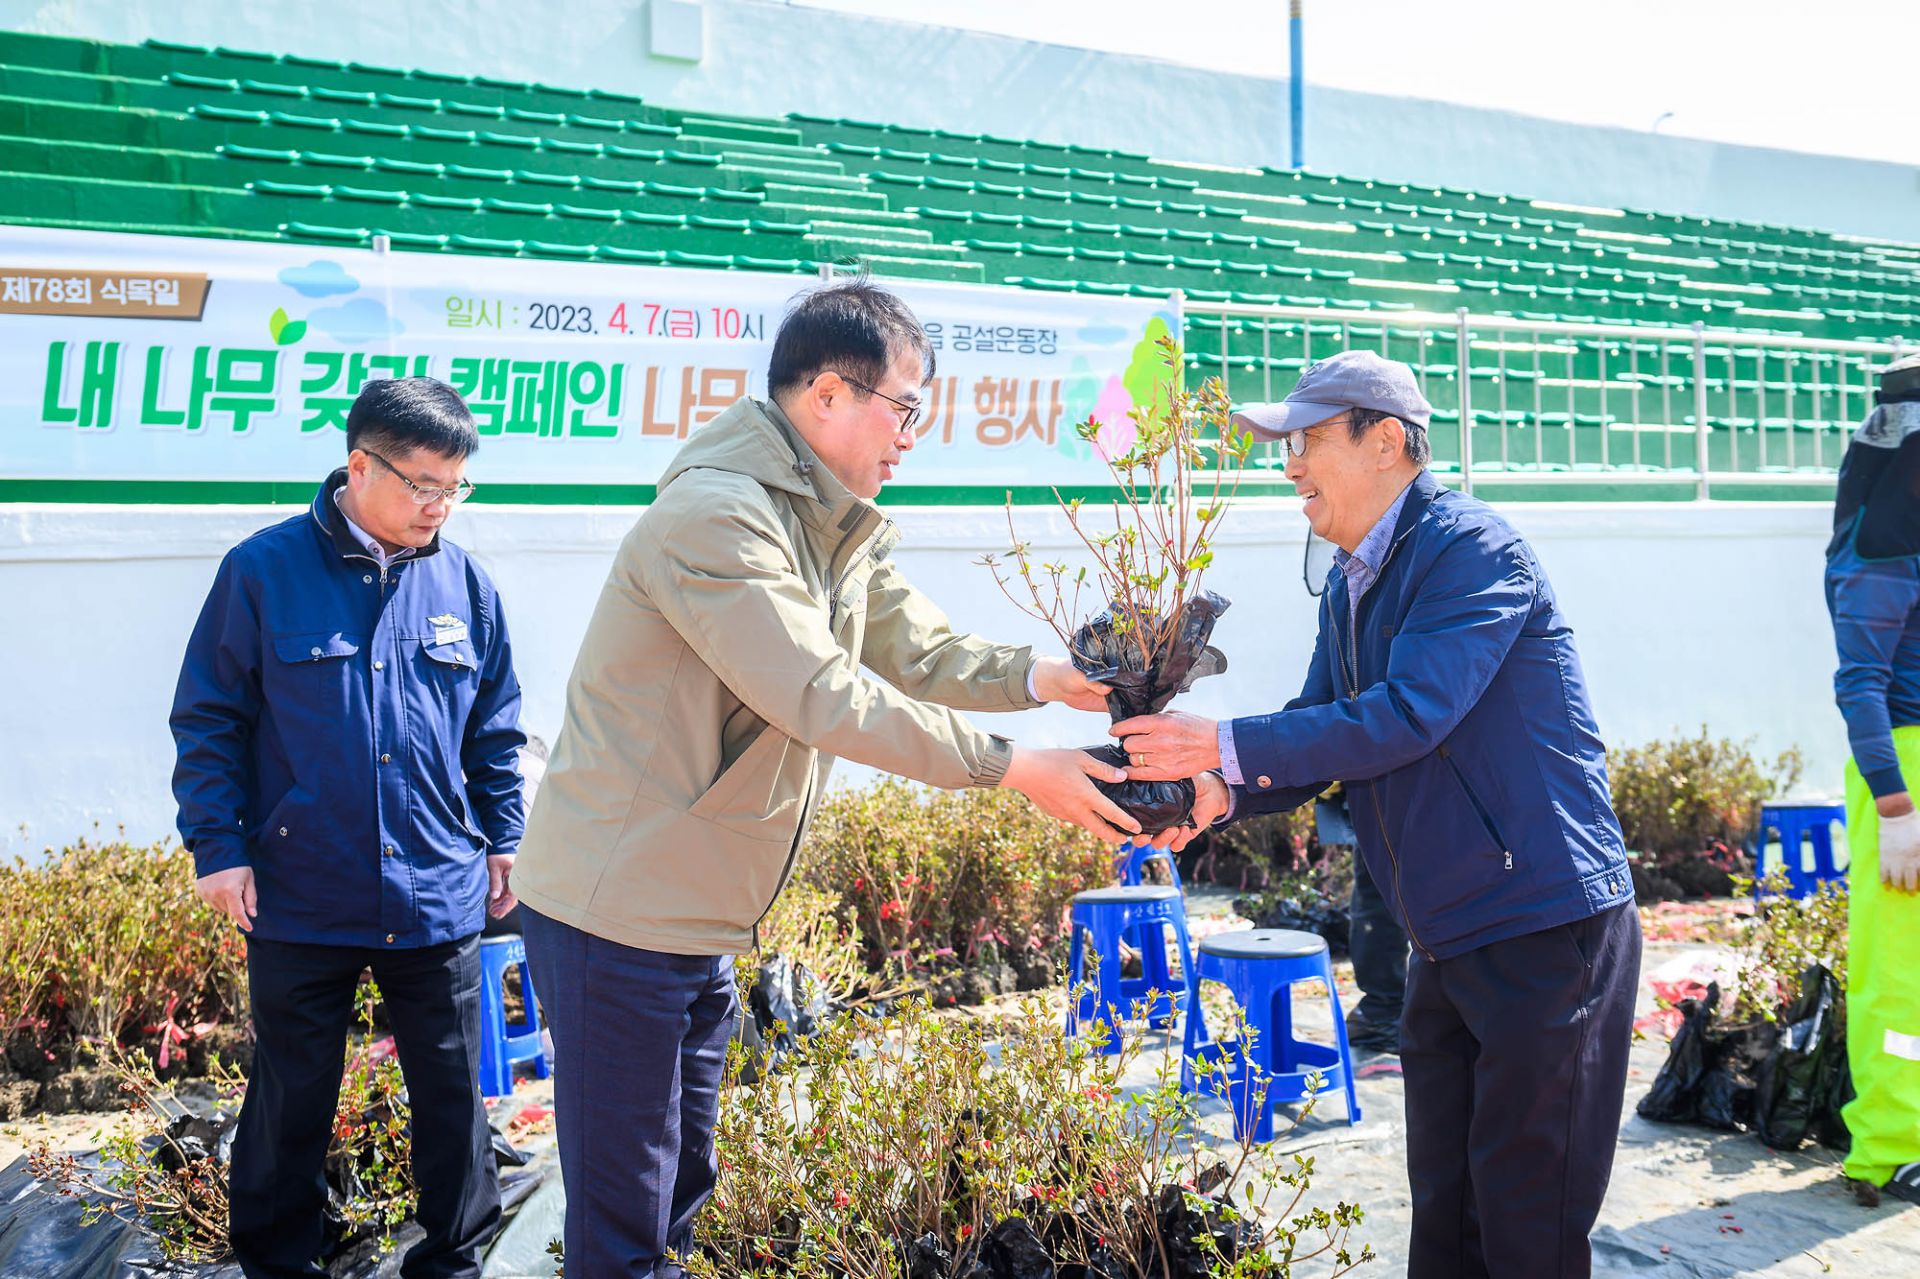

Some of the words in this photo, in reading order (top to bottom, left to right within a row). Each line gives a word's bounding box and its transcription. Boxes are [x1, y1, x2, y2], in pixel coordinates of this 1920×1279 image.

[1, 276, 92, 304] 제78회
[100, 277, 180, 306] 식목일
[445, 295, 502, 329] 일시
[529, 302, 598, 335] 2023.
[711, 307, 764, 340] 10시
[952, 324, 1058, 355] 공설운동장
[42, 340, 121, 428] 내
[140, 345, 280, 432] 나무
[451, 357, 625, 437] 캠페인
[974, 375, 1064, 446] 행사
